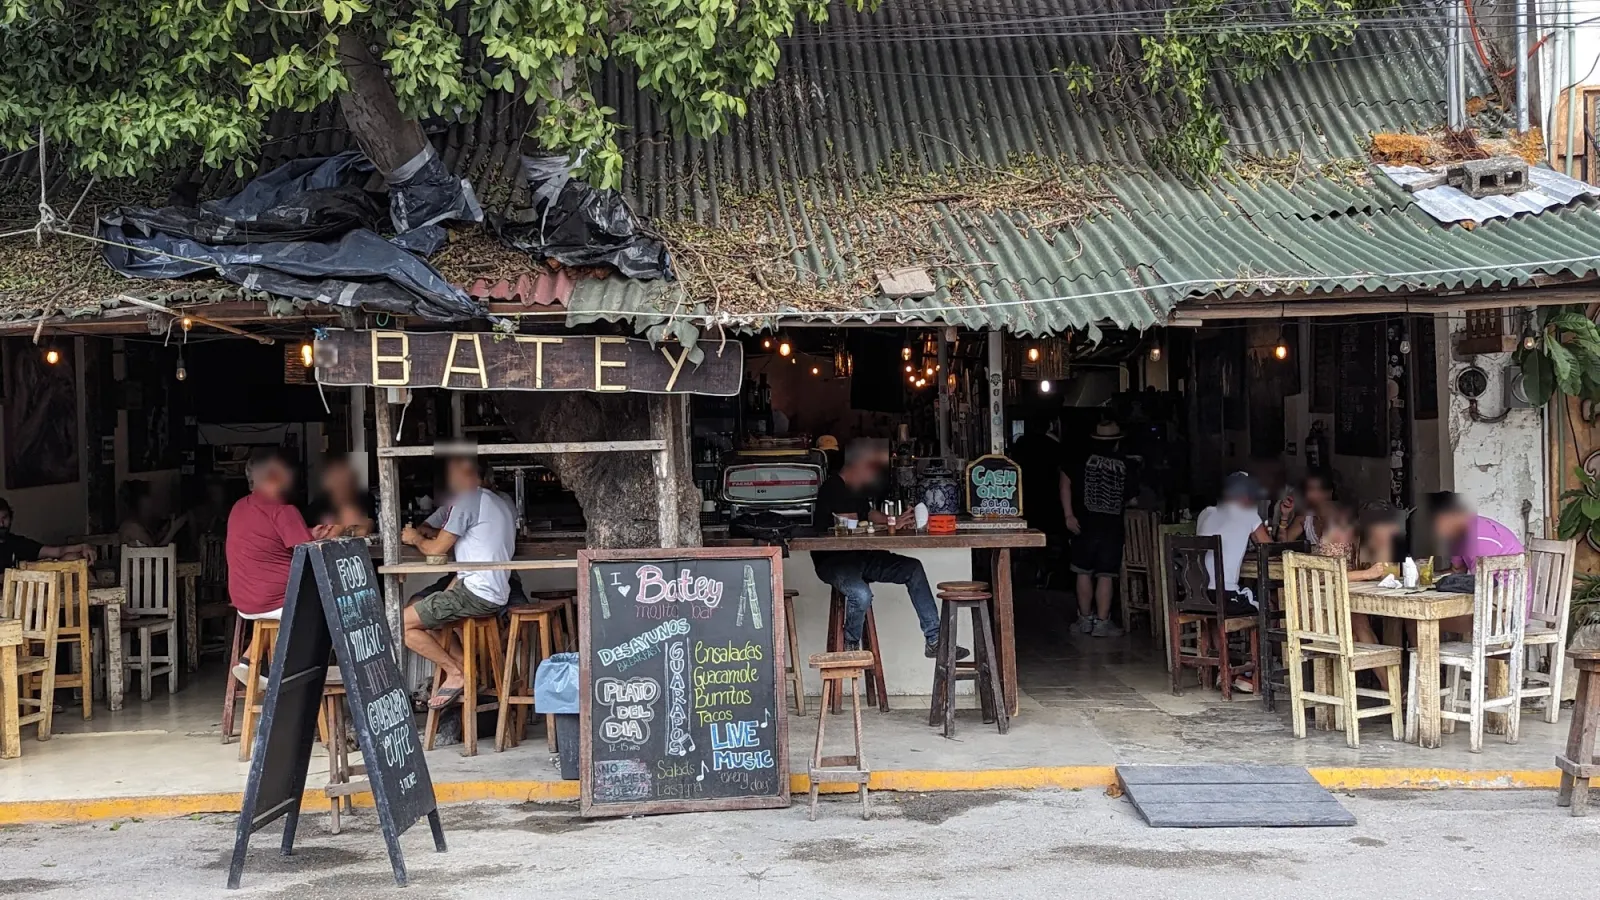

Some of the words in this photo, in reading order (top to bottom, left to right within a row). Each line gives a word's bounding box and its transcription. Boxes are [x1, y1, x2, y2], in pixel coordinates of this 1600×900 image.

[371, 330, 690, 393] BATEY
[971, 465, 1017, 486] CASH
[976, 485, 1017, 499] ONLY
[981, 499, 1010, 508] SOLO
[335, 555, 368, 592] FOOD
[635, 564, 724, 608] Batey
[690, 602, 716, 619] bar
[597, 617, 691, 667] DESAYUNOS
[693, 661, 760, 690] Guacamole
[603, 682, 657, 703] PLATO
[616, 704, 651, 720] DEL
[695, 709, 734, 728] Tacos
[605, 719, 643, 740] DIA
[710, 720, 760, 750] LIVE
[713, 749, 775, 771] MUSIC
